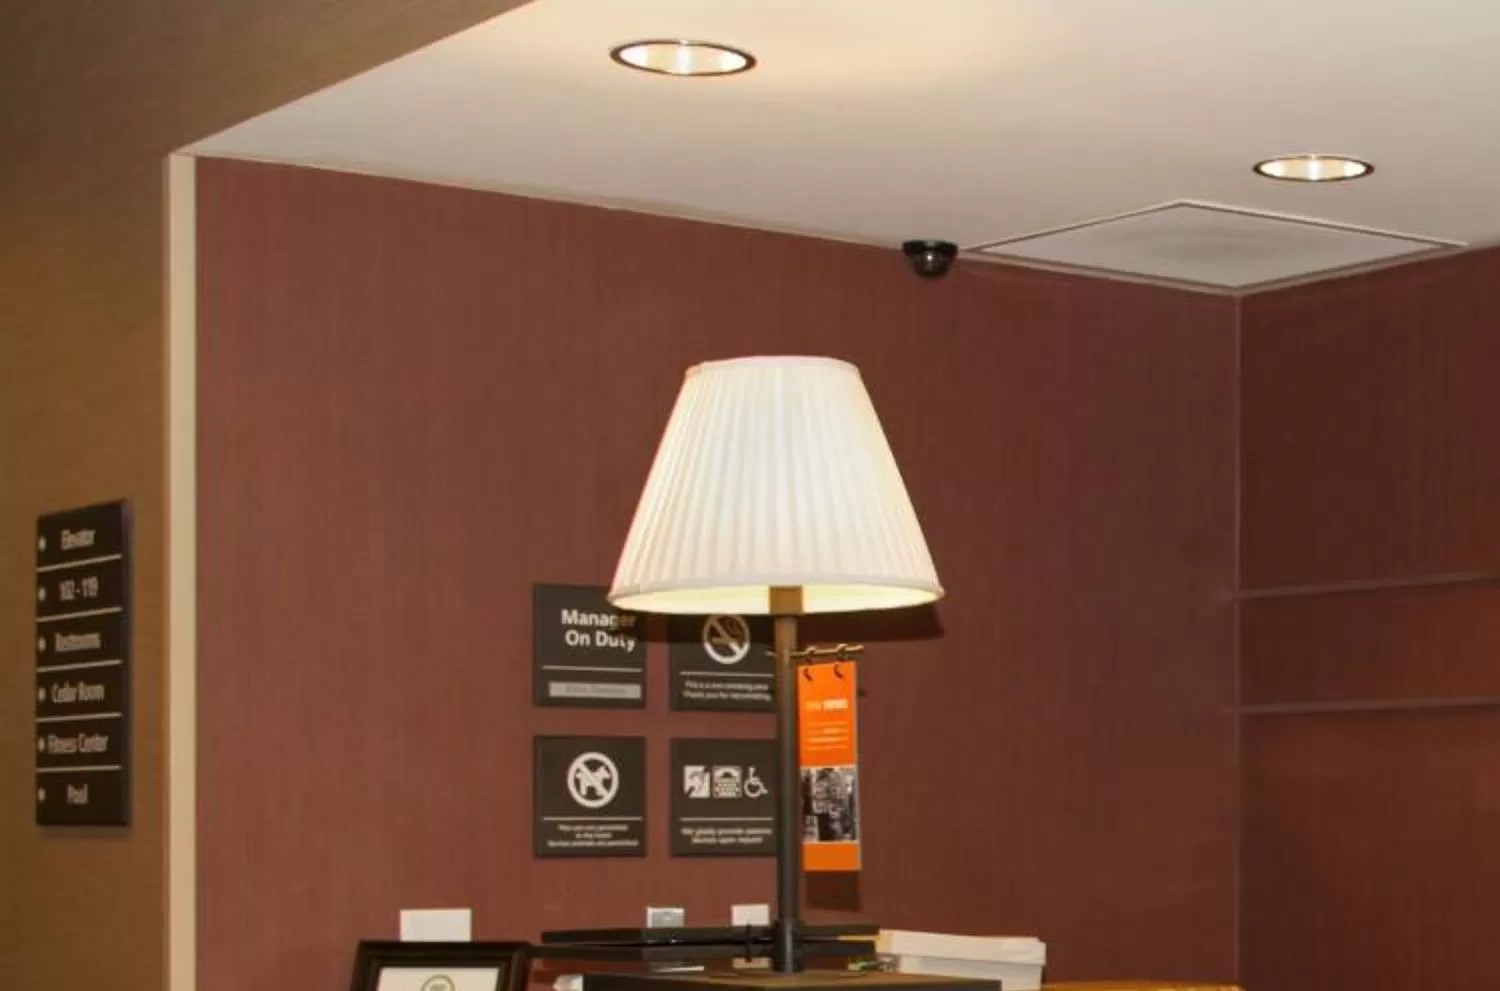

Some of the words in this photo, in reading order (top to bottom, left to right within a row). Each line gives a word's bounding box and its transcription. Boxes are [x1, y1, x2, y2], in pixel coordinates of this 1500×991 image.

[561, 609, 636, 630] Manager
[565, 629, 591, 647] On
[595, 630, 636, 653] Duty
